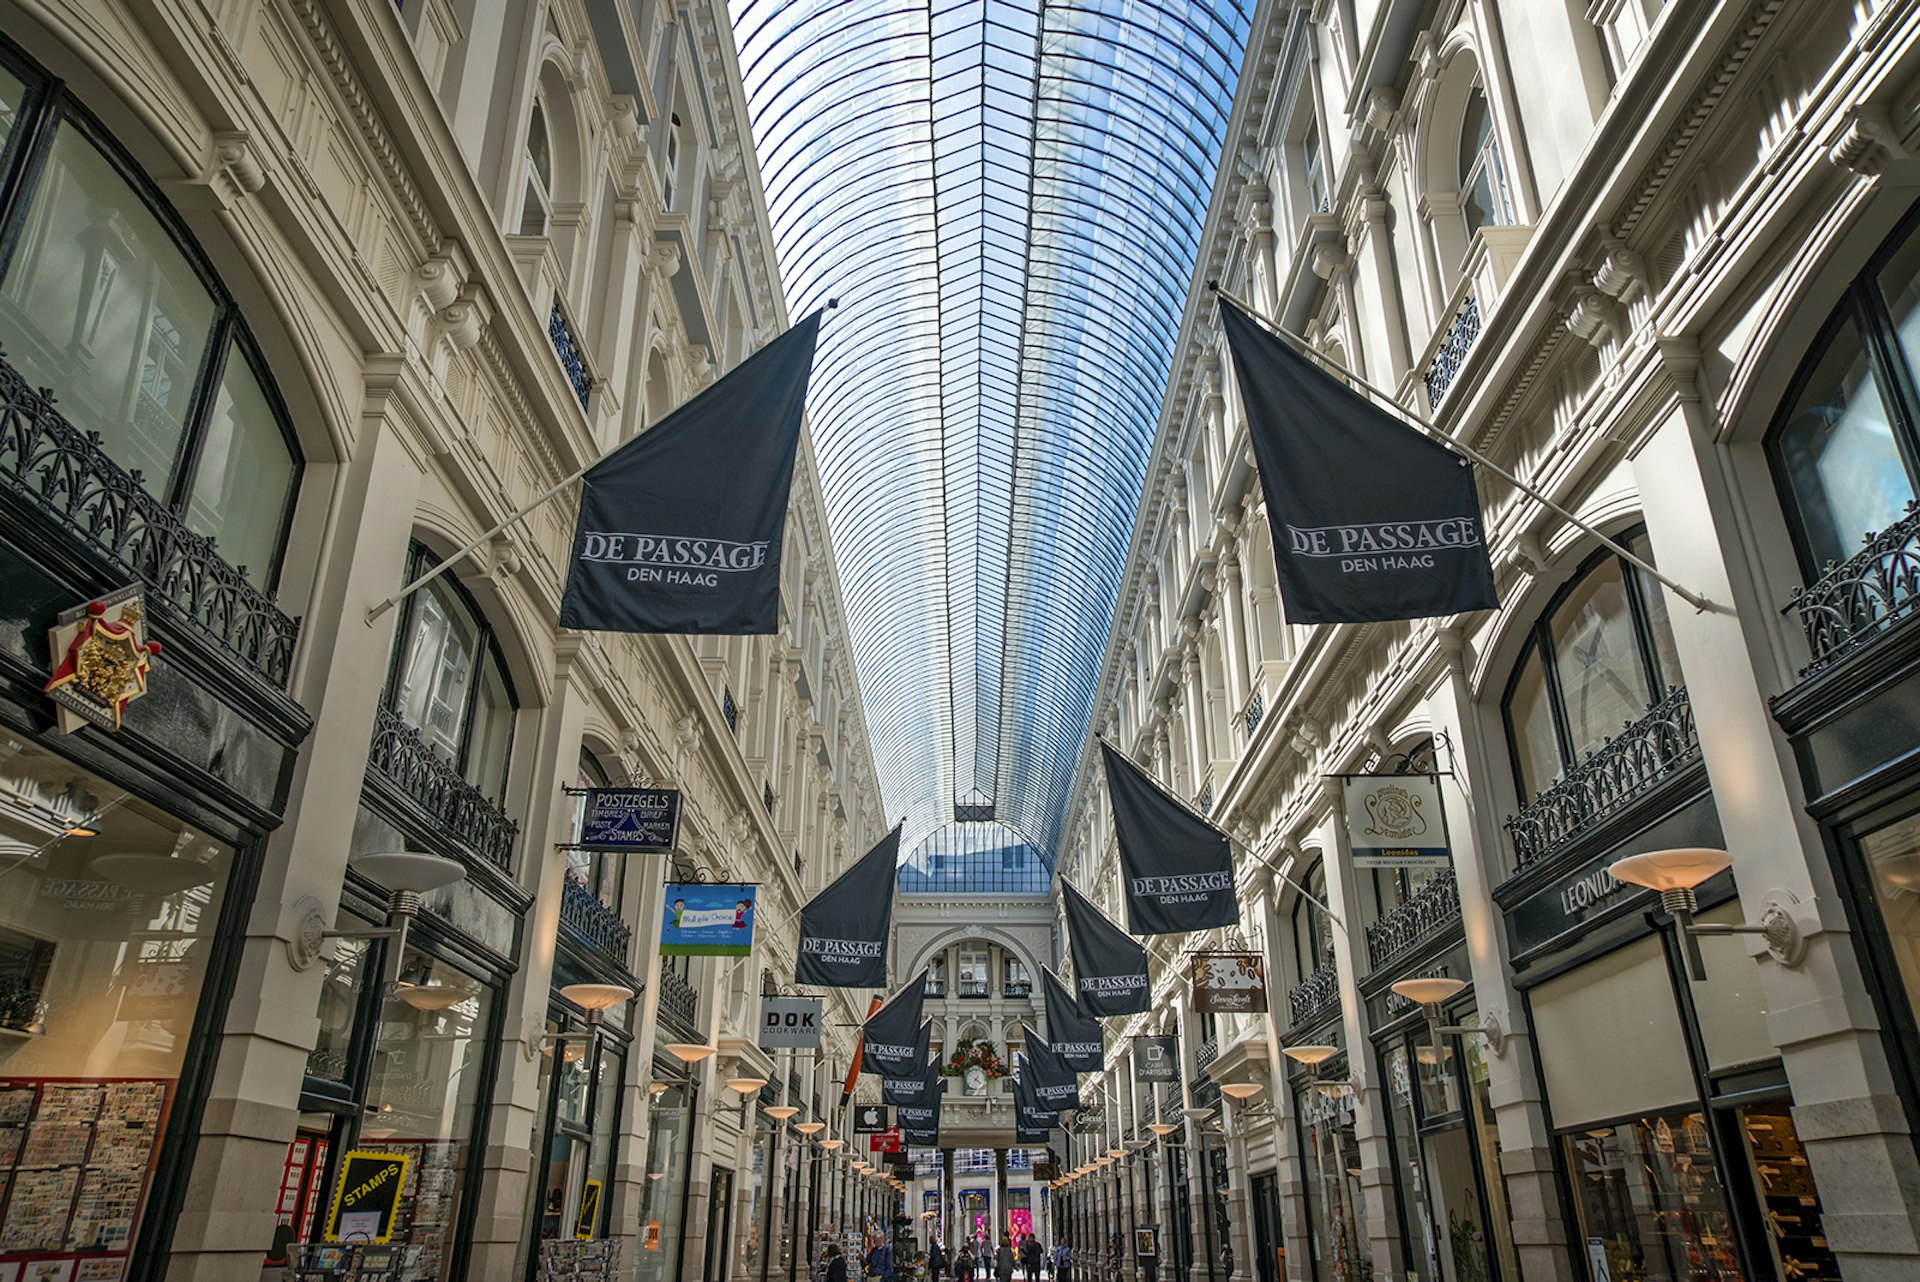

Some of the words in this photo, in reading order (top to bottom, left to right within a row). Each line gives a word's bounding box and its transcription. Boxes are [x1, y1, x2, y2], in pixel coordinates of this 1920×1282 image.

[1290, 528, 1331, 555] DE
[1338, 520, 1480, 552] PASSAGE
[582, 534, 625, 560] DE
[633, 537, 768, 569] PASSAGE
[1341, 557, 1379, 573] DEN
[1382, 554, 1435, 571] HAAG
[626, 567, 663, 583] DEN
[666, 570, 719, 587] HAAG
[595, 793, 669, 809] POSTZEGELS
[609, 829, 644, 841] STAMPS
[1382, 849, 1419, 857] Leonidas
[1133, 879, 1156, 894] DE
[1160, 873, 1231, 892] PASSAGE
[1160, 895, 1180, 904] DEN
[1181, 893, 1208, 902] HAAG
[803, 939, 821, 951] DE
[824, 940, 881, 956] PASSAGE
[821, 955, 837, 963] DEN
[1080, 978, 1095, 990] DE
[1098, 976, 1147, 989] PASSAGE
[767, 1012, 815, 1027] DOK
[864, 1043, 877, 1053] DE
[878, 1045, 914, 1057] PASSAGE
[1052, 1043, 1062, 1053] DE
[1064, 1042, 1102, 1053] PASSAGE
[884, 1080, 894, 1089] DE
[895, 1081, 924, 1090] PASSAGE
[1036, 1087, 1047, 1096] DE
[1047, 1084, 1076, 1094] PASSAGE
[344, 1163, 399, 1207] STAMPS
